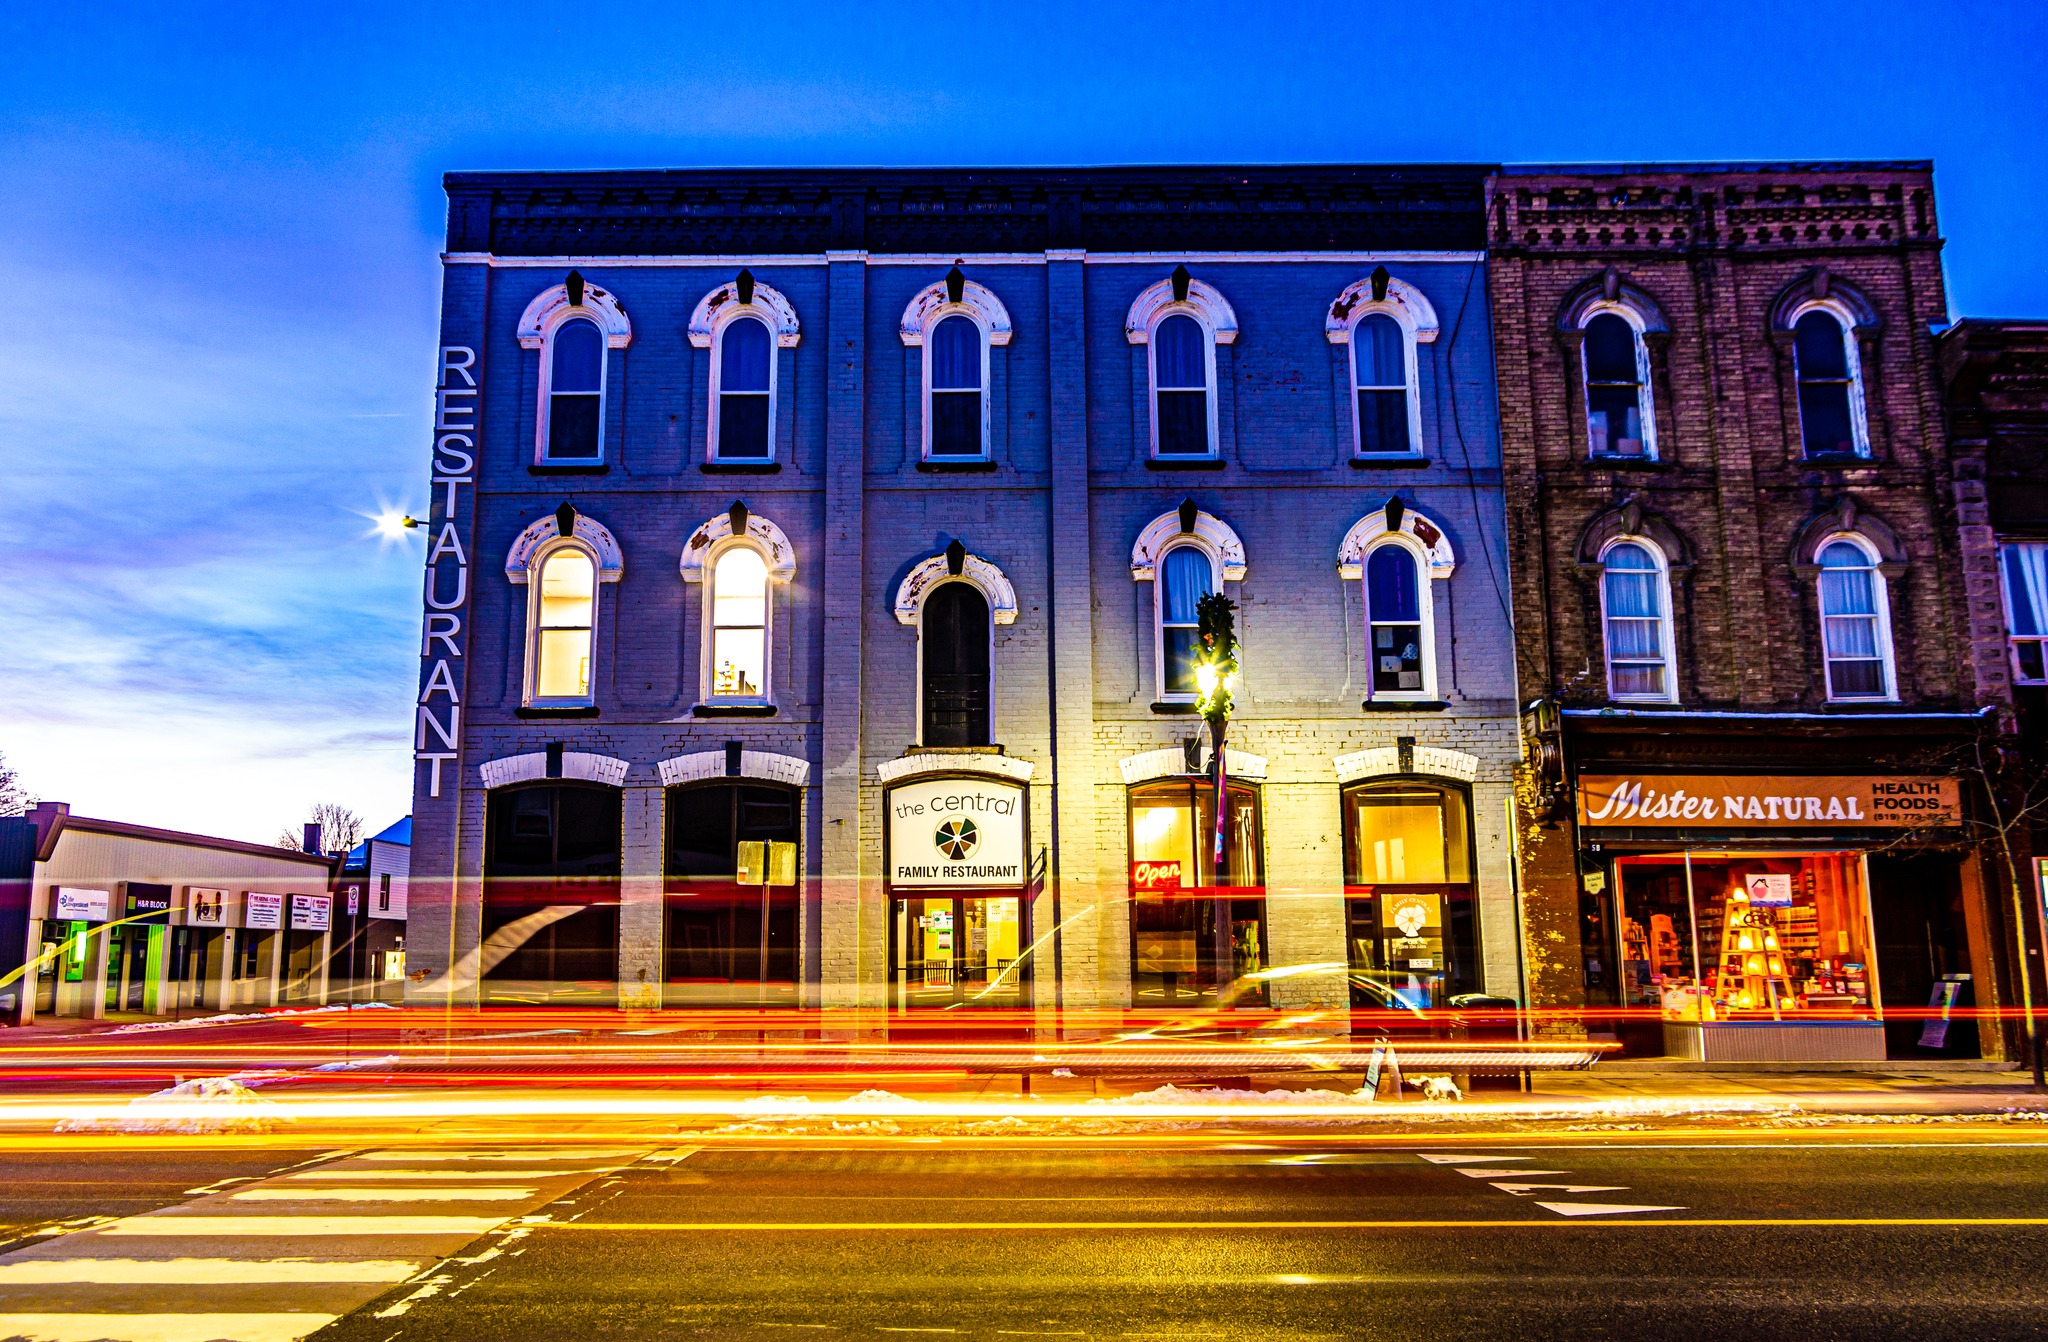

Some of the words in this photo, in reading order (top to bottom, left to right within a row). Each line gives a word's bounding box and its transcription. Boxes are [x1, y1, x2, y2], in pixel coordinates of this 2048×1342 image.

[416, 345, 478, 797] RESTAURANT
[1872, 783, 1940, 795] HEALTH
[895, 803, 925, 819] the
[930, 792, 1016, 816] central
[1586, 780, 1719, 820] Mister
[1723, 796, 1864, 821] NATURAL
[1873, 798, 1940, 810] FOODS
[898, 866, 939, 878] FAMILY
[942, 865, 1018, 878] RESTAURANT
[1135, 863, 1181, 887] Open
[137, 899, 149, 908] H&R
[150, 901, 168, 909] BLOCK
[1390, 898, 1408, 914] FAMILY
